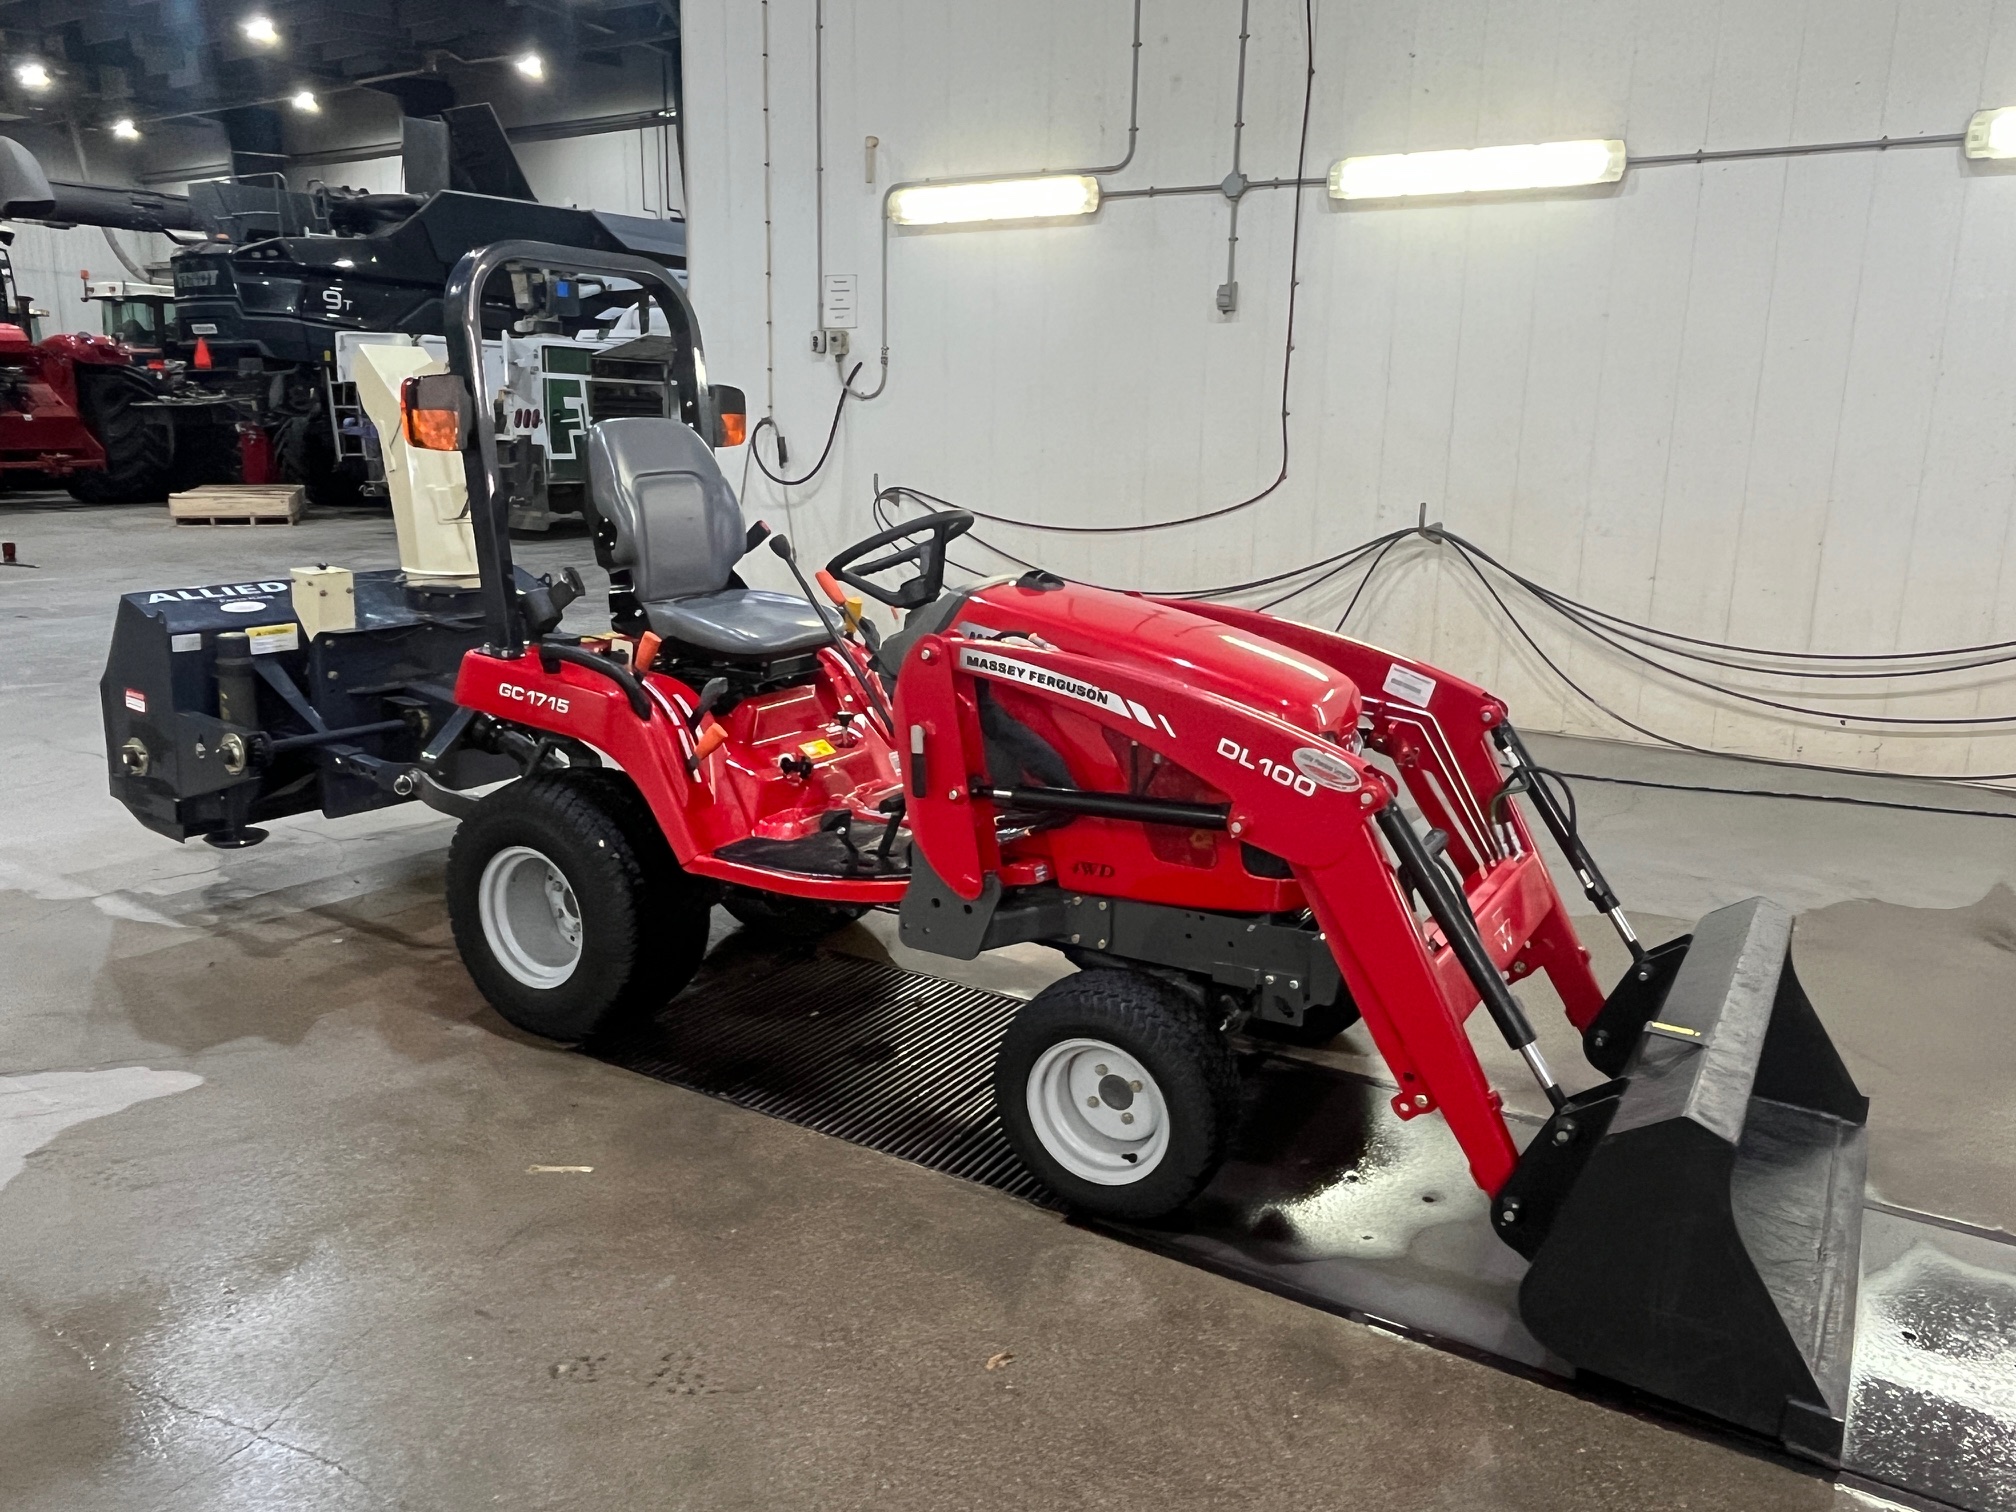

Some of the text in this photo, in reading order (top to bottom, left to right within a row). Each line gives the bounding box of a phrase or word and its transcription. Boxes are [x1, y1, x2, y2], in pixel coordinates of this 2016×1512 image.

[149, 581, 288, 603] ALLIED
[499, 682, 570, 714] GC1715
[966, 655, 1109, 705] MASSEY FERGUSON
[1216, 737, 1317, 797] DL100
